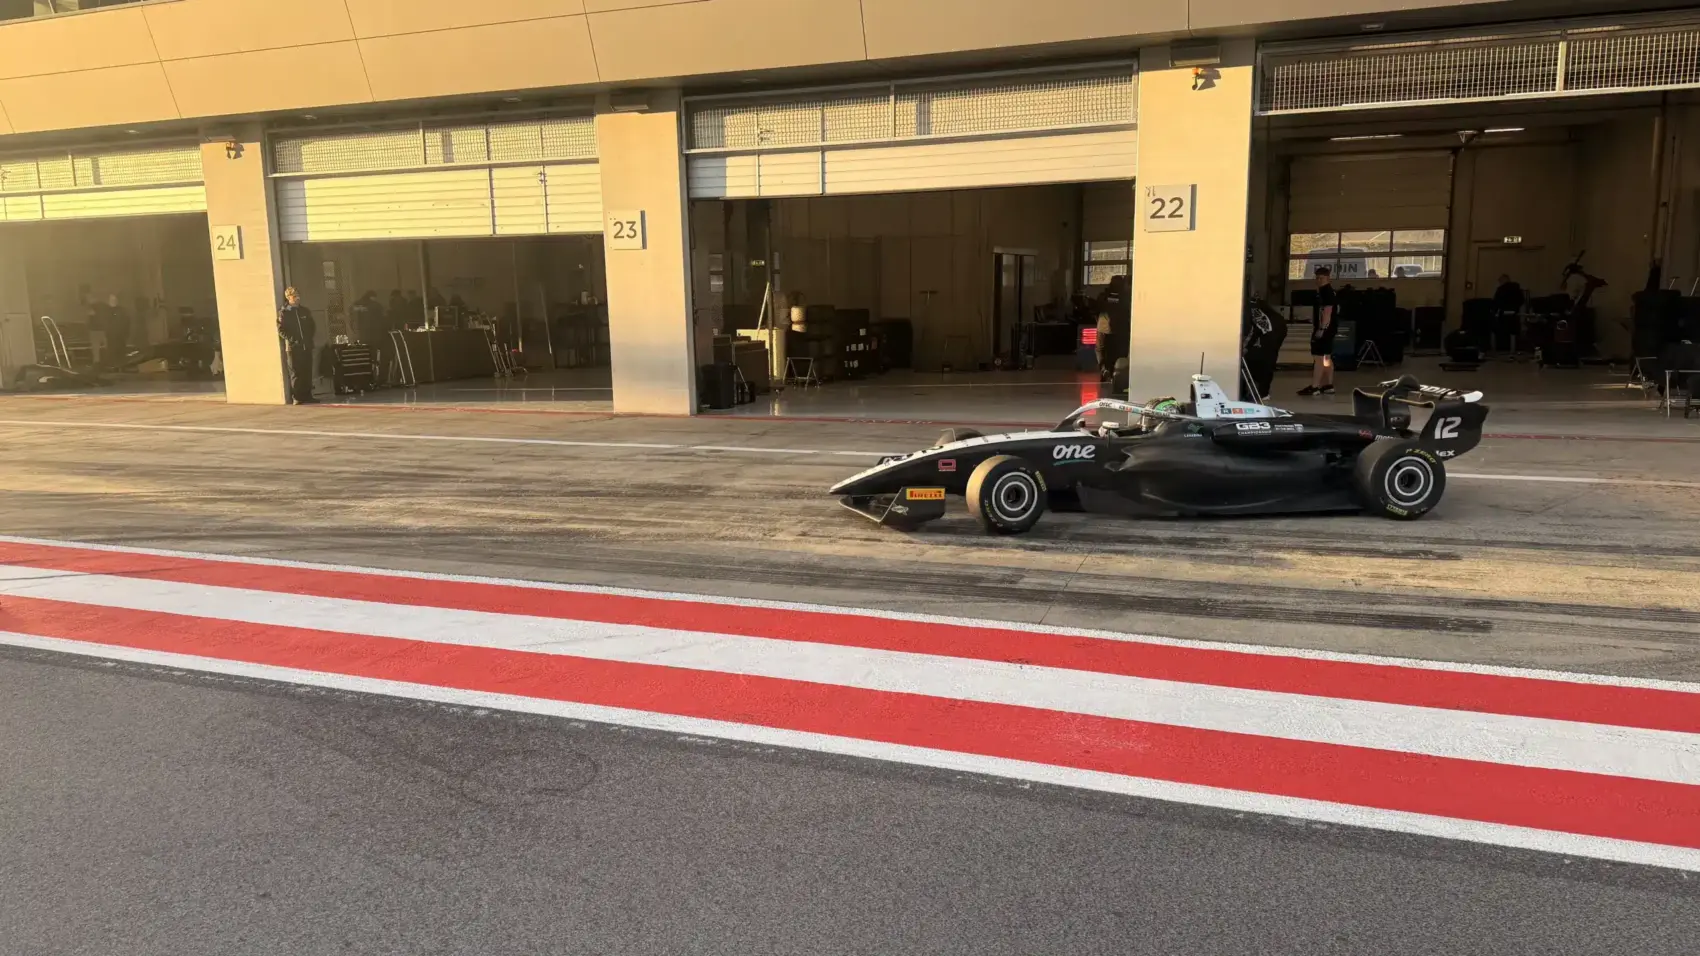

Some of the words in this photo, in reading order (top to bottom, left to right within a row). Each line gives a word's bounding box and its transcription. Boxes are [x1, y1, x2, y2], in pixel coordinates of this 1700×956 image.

[1150, 197, 1184, 219] 22
[613, 221, 637, 239] 23
[216, 234, 236, 250] 24
[1236, 421, 1271, 430] GB3
[1434, 416, 1461, 439] 12
[1052, 444, 1096, 460] one
[910, 490, 942, 498] PIRELLI
